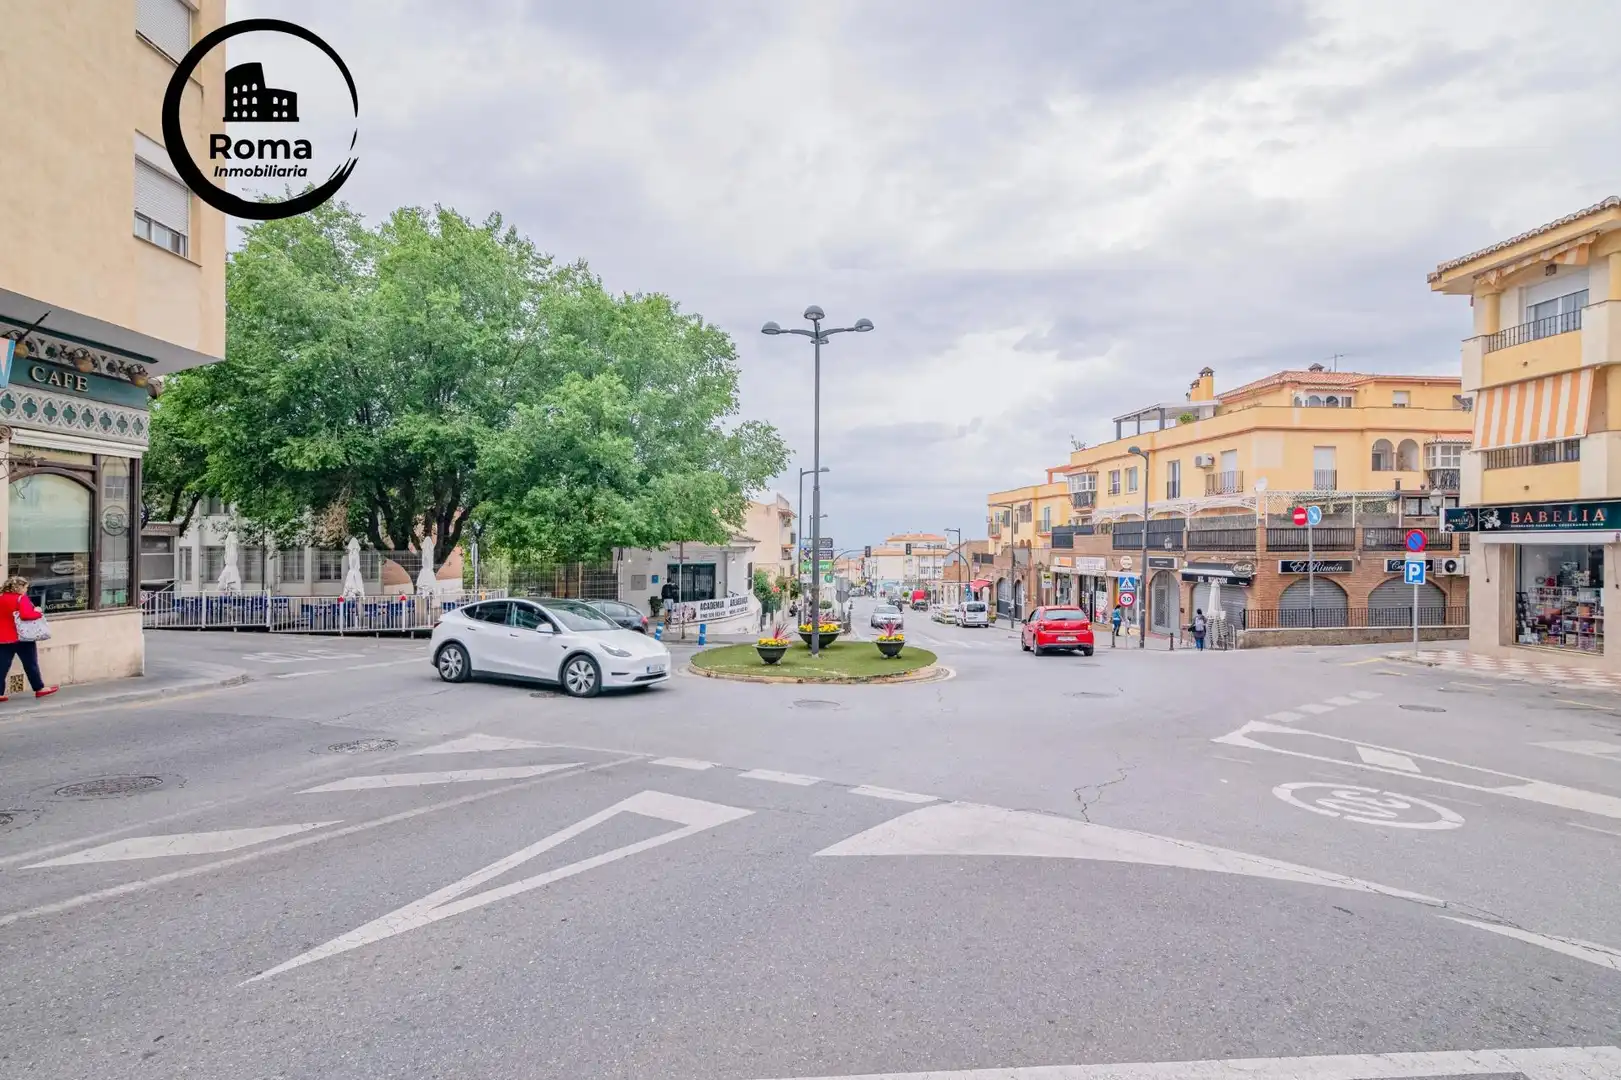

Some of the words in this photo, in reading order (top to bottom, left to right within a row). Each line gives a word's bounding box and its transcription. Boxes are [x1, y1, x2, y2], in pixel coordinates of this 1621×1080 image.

[31, 366, 89, 392] CAFE
[1511, 509, 1605, 523] BABELIA
[1290, 561, 1306, 572] El
[1307, 561, 1343, 572] Rincón
[1408, 563, 1421, 581] P
[700, 601, 725, 611] ACADEMIA
